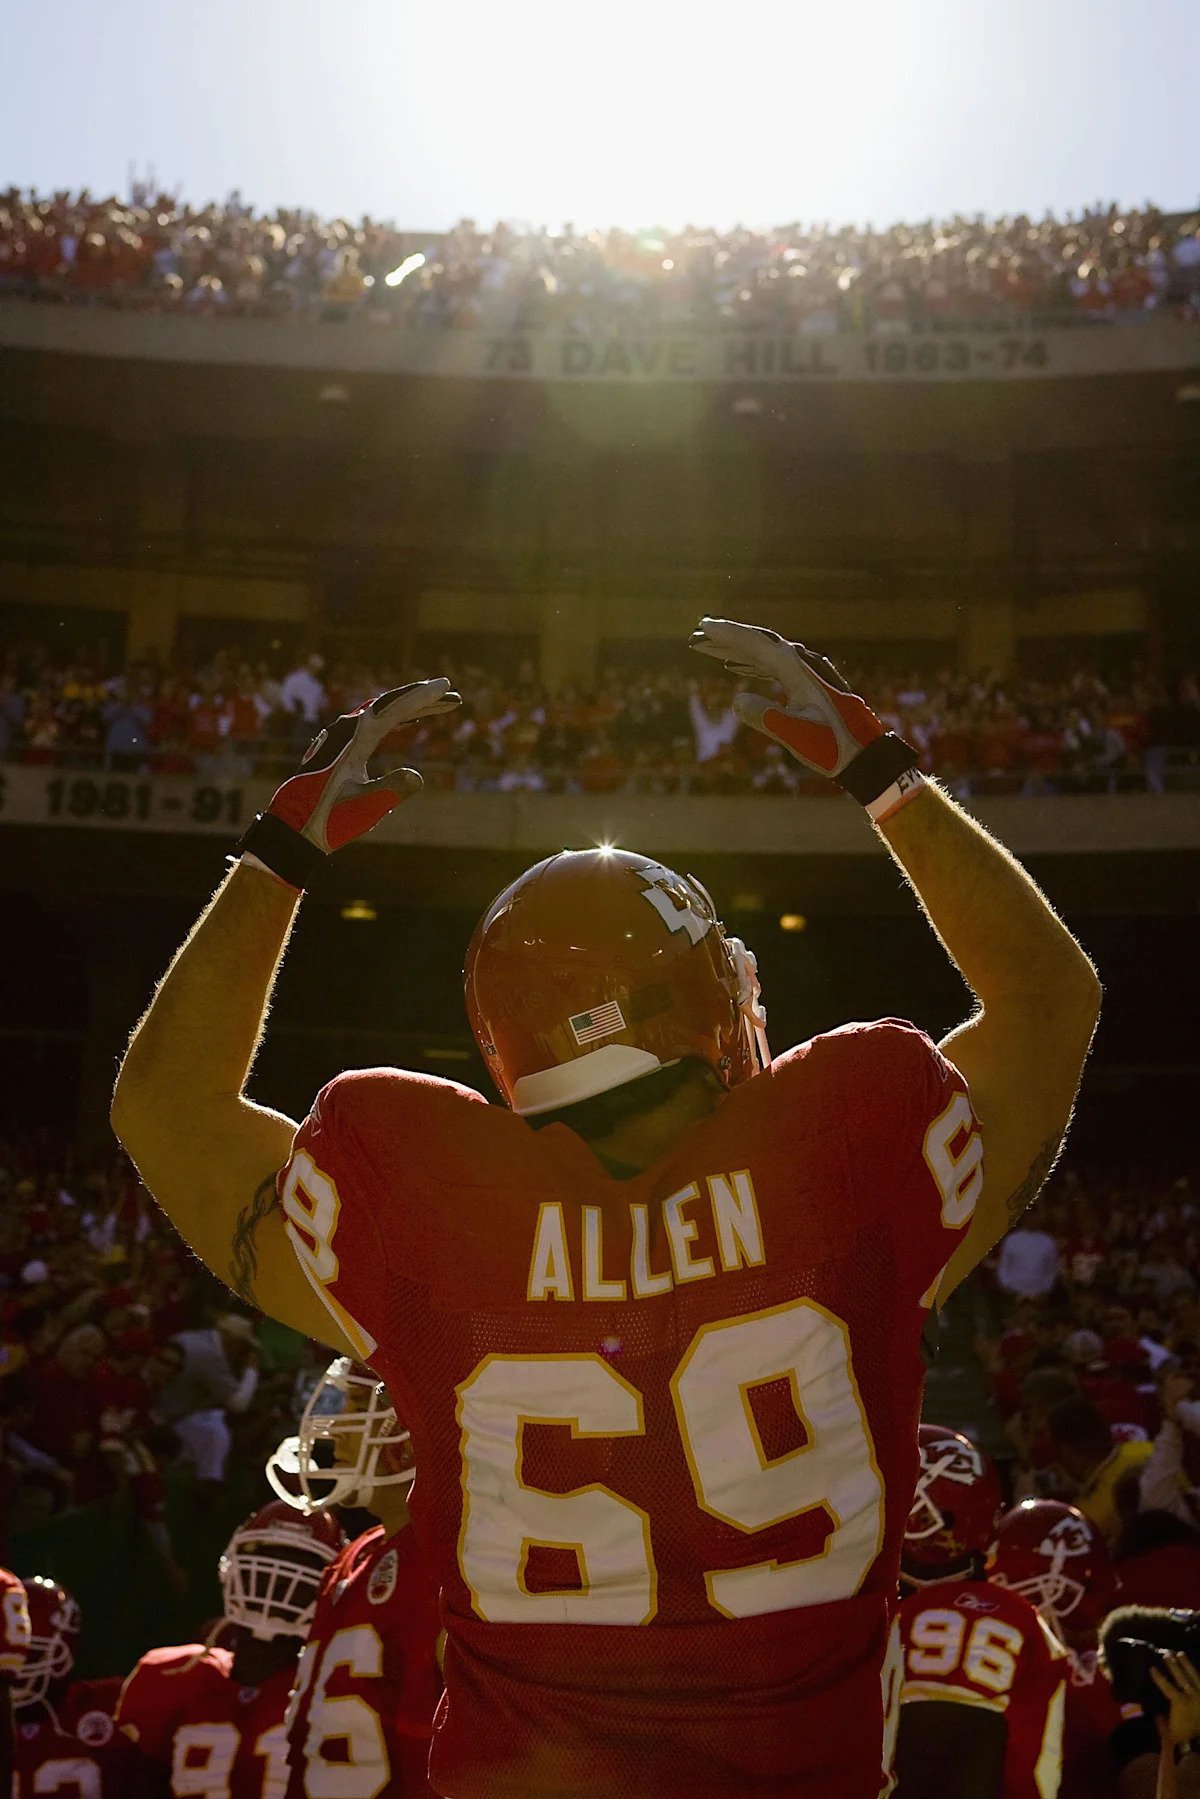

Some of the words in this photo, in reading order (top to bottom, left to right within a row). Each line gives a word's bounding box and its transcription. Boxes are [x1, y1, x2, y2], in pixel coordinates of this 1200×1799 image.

[561, 341, 697, 375] DAVE
[724, 341, 839, 375] HILL
[47, 777, 242, 825] 1981-91
[527, 1168, 767, 1302] ALLEN
[453, 1296, 886, 1627] 69
[908, 1607, 1025, 1694] 96
